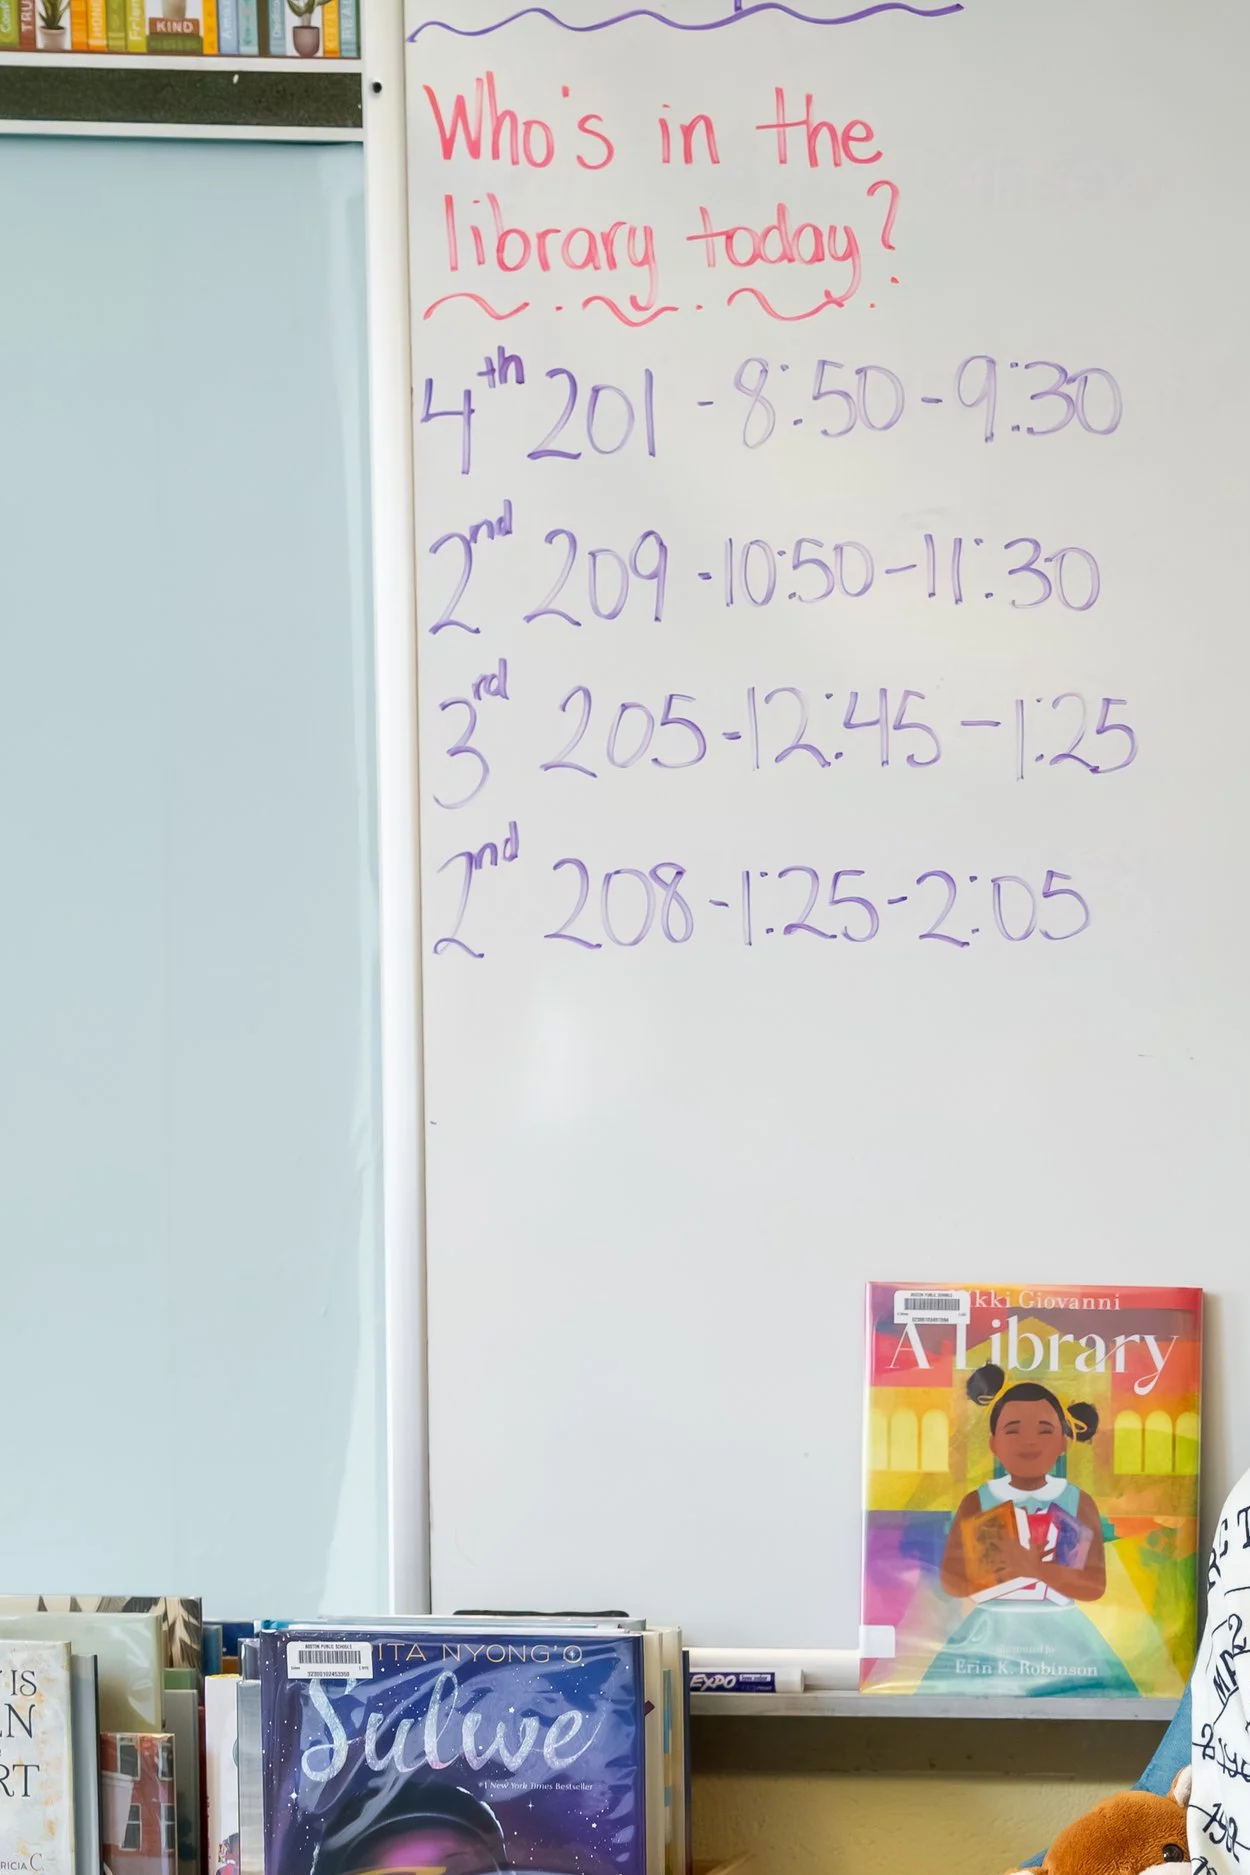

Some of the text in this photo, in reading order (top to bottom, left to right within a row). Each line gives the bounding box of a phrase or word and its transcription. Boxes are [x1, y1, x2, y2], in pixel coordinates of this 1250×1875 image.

[156, 20, 195, 33] KIND
[423, 70, 883, 170] Who's in the
[444, 179, 900, 311] library today?
[527, 368, 656, 460] 201
[429, 499, 514, 635] 2nd
[523, 529, 668, 627] 209
[432, 657, 510, 810] 3rd
[540, 685, 707, 779] 205
[432, 820, 520, 960] 2nd
[543, 857, 695, 950] 208
[966, 1288, 1121, 1311] ikki Giovanni
[887, 1316, 1180, 1396] A Library
[11, 1669, 38, 1697] IS
[374, 1643, 427, 1662] ITA
[689, 1673, 738, 1691] EXPO
[955, 1658, 1099, 1677] Erin K. Robinson
[301, 1669, 605, 1783] Sulwe
[555, 1782, 594, 1791] Bestseller
